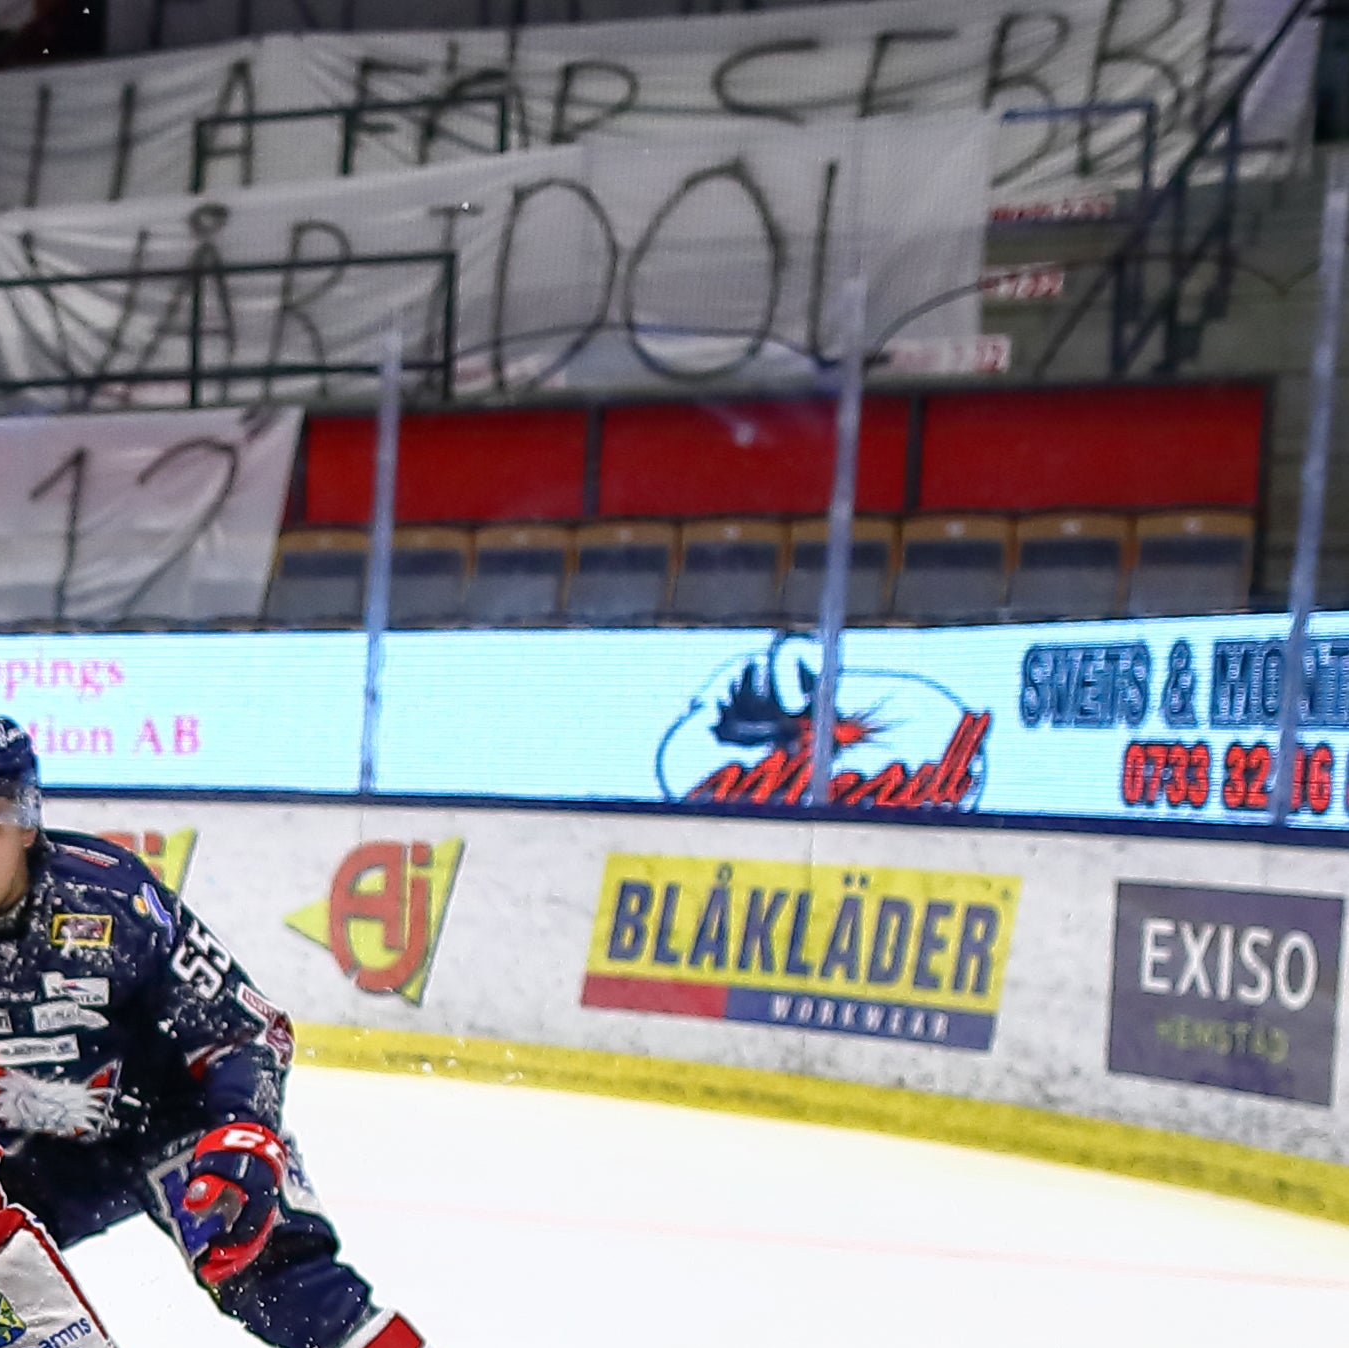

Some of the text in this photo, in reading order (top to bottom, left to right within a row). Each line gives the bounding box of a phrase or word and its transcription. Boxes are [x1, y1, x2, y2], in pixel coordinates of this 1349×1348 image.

[607, 864, 1000, 997] BLÅKLÄDER
[1140, 917, 1319, 1011] EXISO
[770, 994, 951, 1042] WORKWEAR
